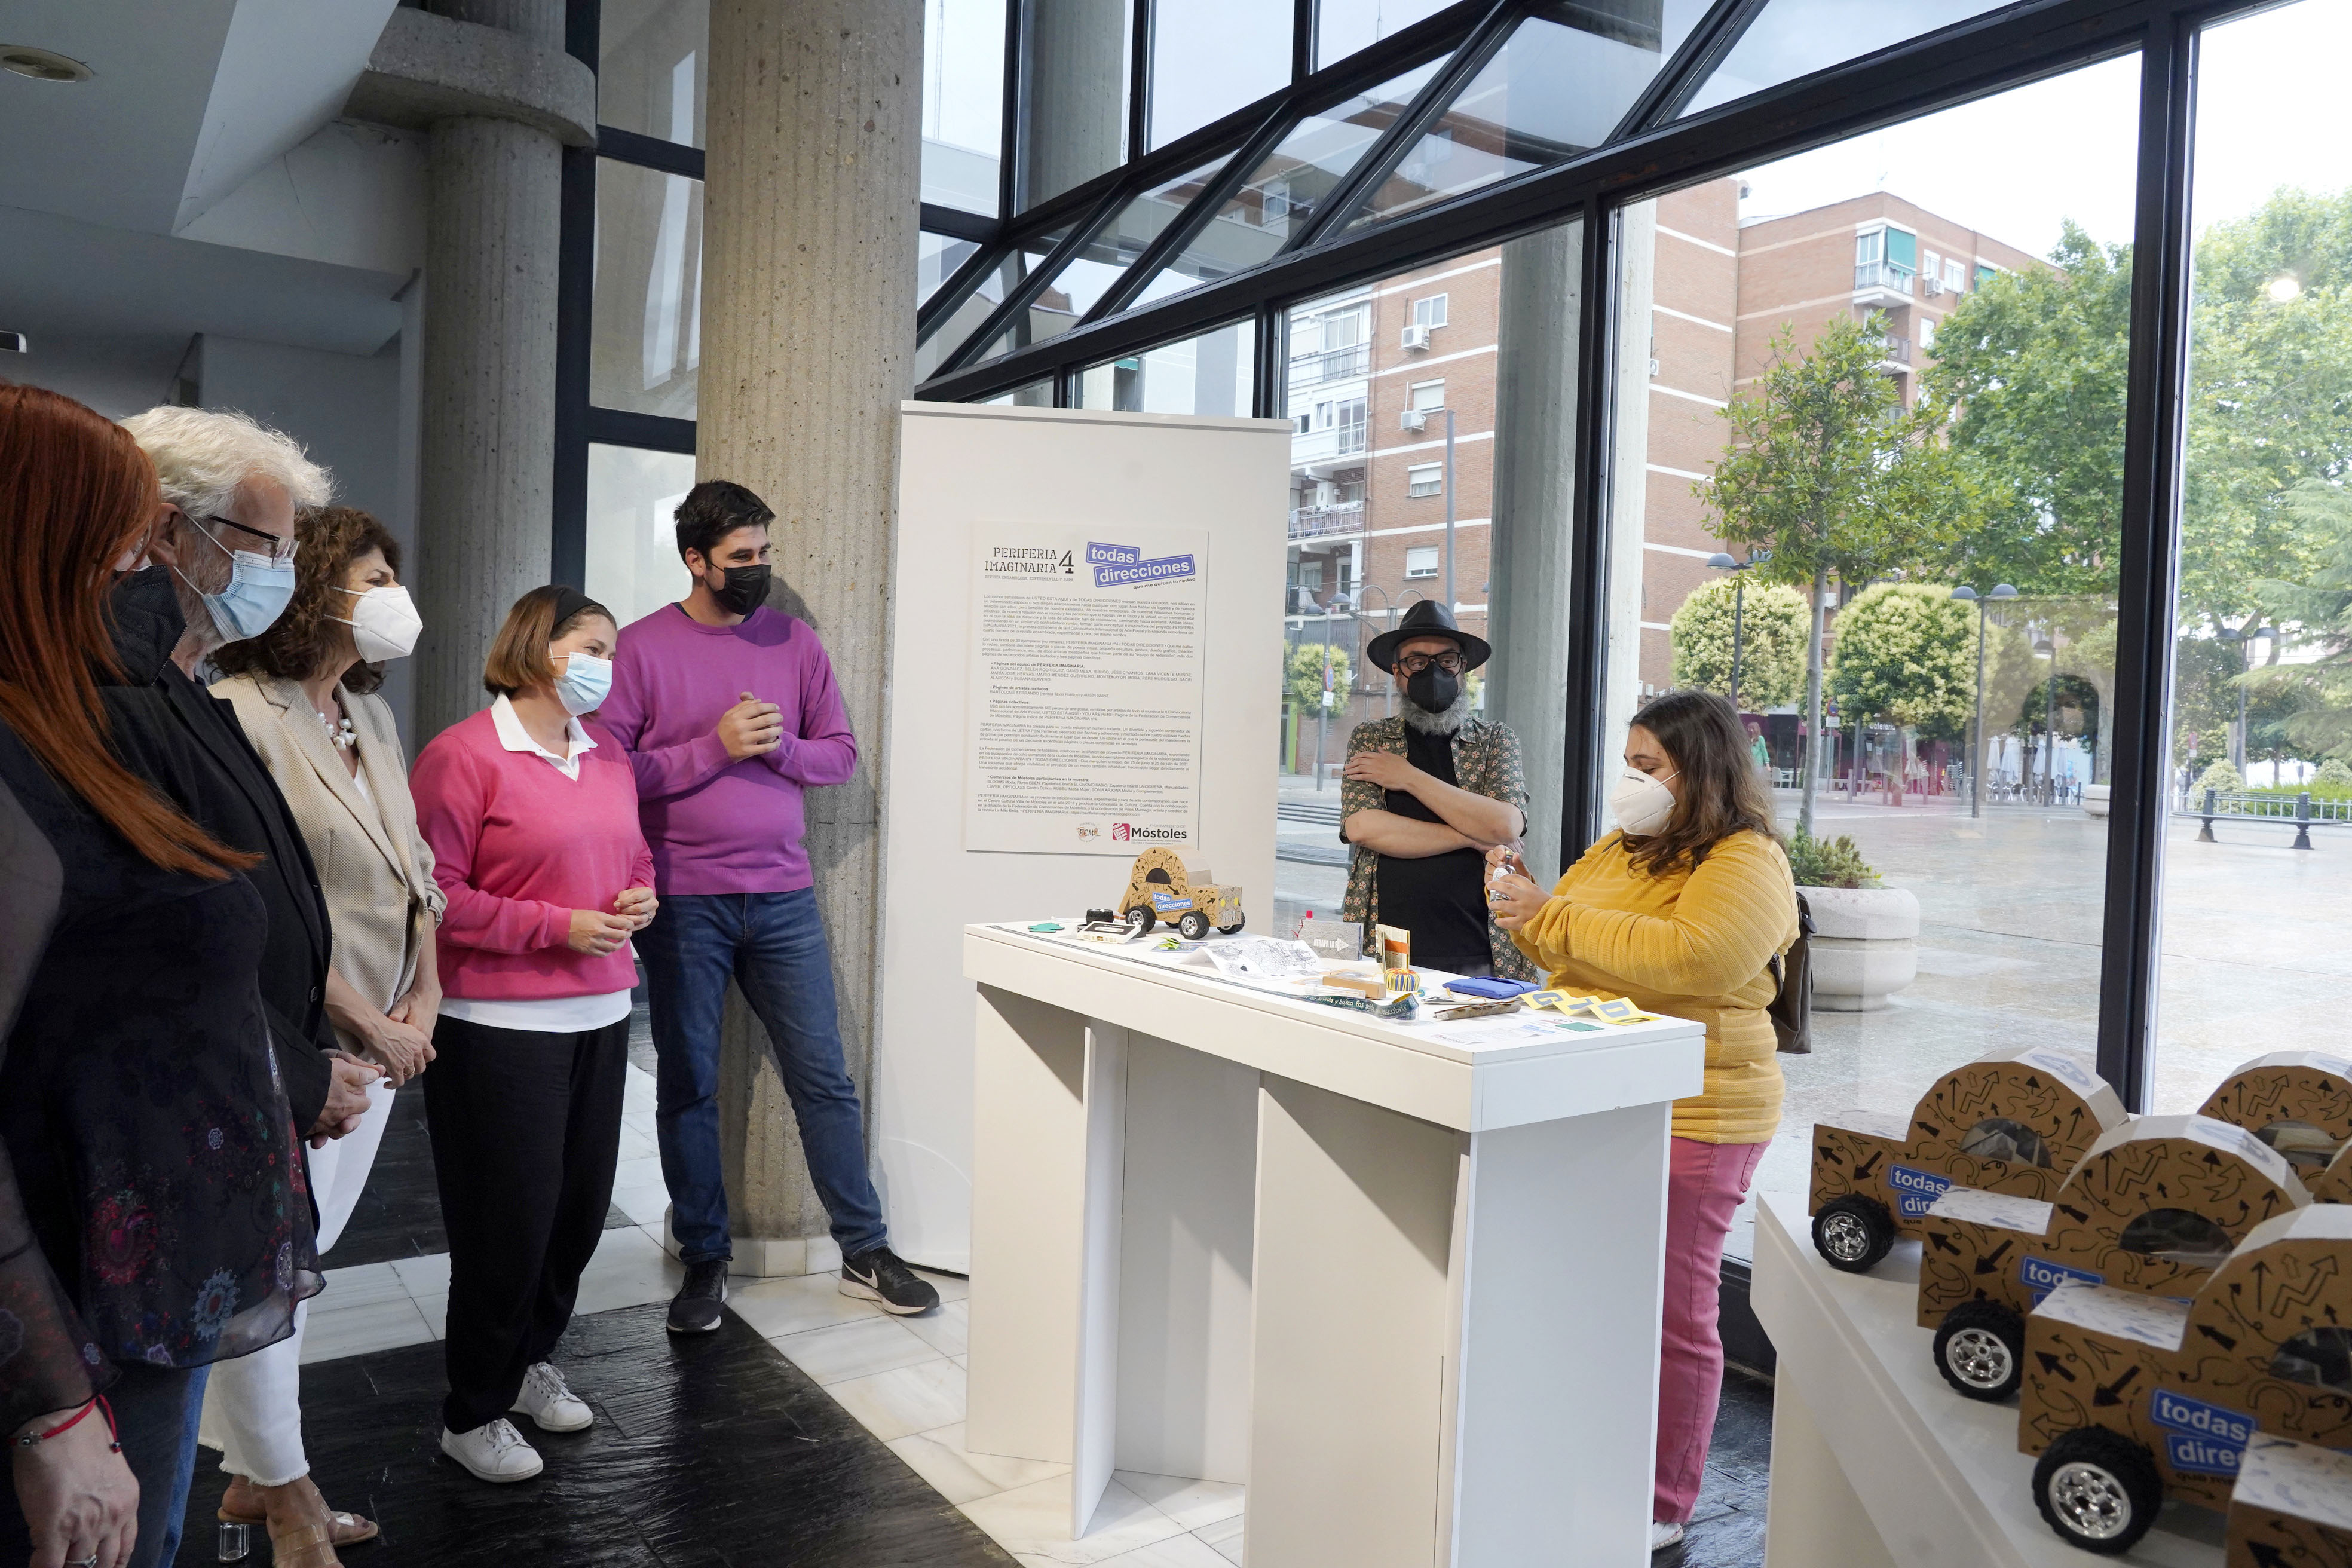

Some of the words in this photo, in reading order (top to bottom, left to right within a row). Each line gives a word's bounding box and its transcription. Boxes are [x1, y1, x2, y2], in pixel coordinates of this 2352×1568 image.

[993, 547, 1057, 559] PERIFERIA
[1091, 547, 1135, 564] todas
[985, 561, 1057, 573] IMAGINARIA
[1058, 550, 1074, 574] 4
[1100, 562, 1190, 583] direcciones
[1131, 828, 1187, 839] Móstoles
[1154, 893, 1171, 902] todas
[1157, 901, 1191, 909] direcciones
[1895, 1170, 1946, 1195] todas
[2161, 1397, 2247, 1441] todas
